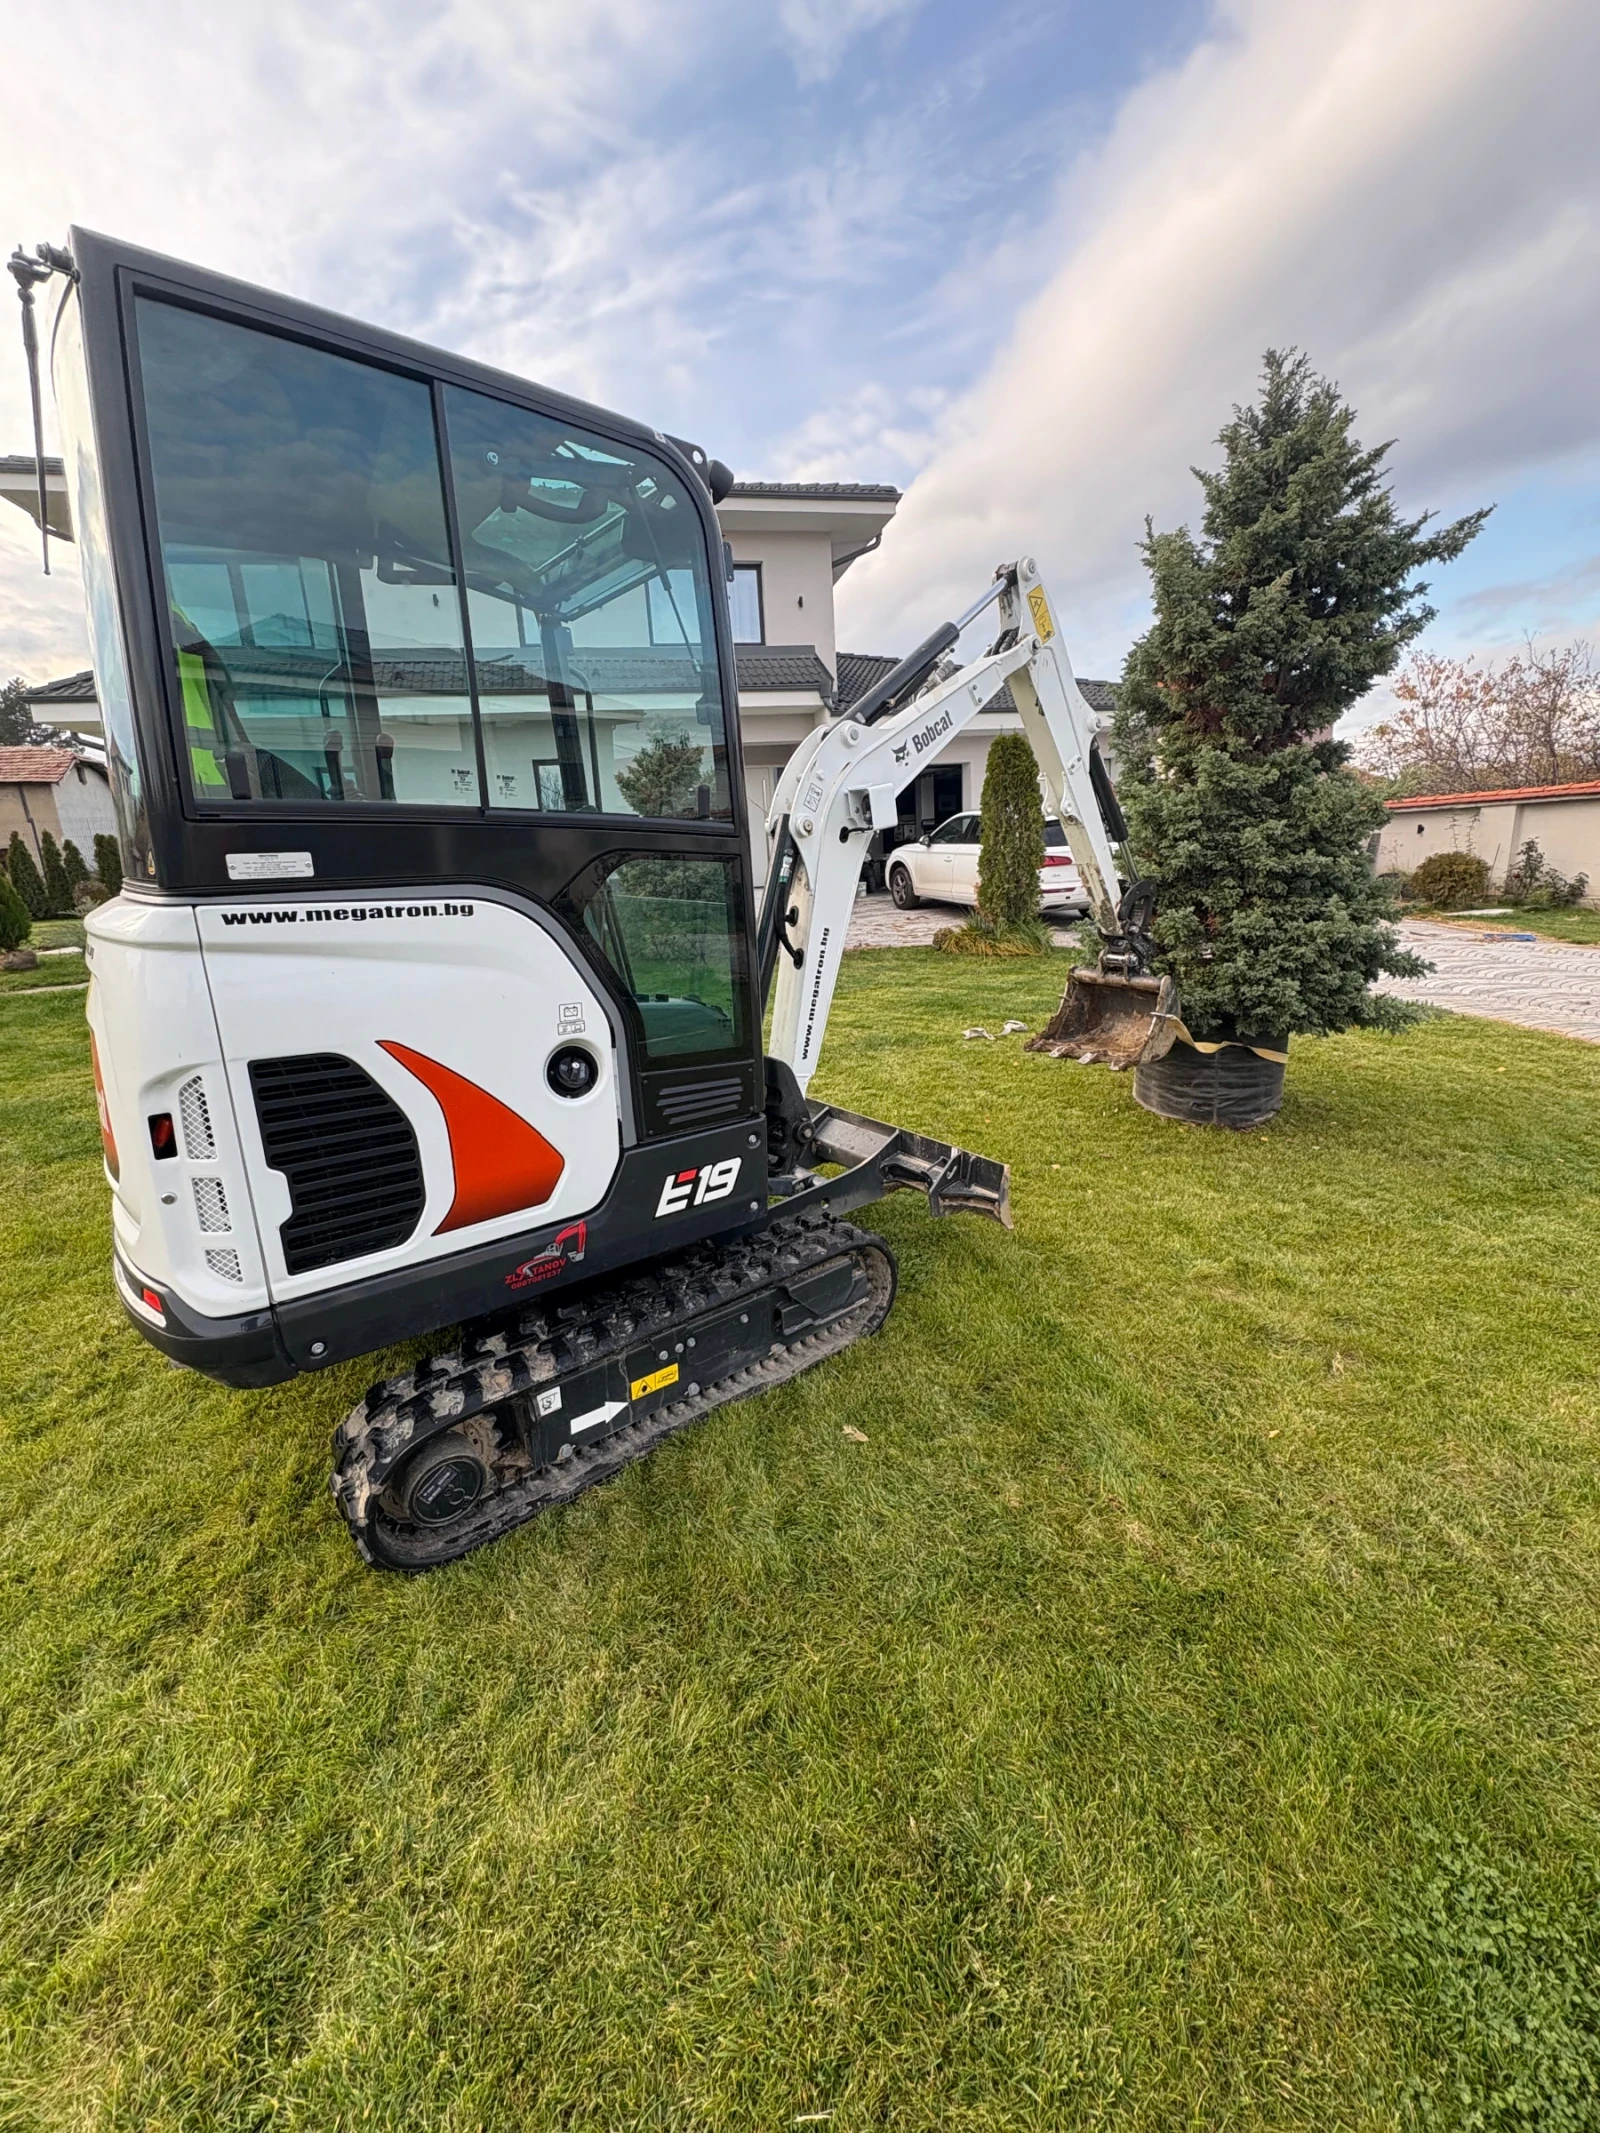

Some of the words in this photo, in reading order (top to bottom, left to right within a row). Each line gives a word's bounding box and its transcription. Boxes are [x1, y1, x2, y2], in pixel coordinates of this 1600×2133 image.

[911, 709, 954, 754] Bobcat
[221, 903, 475, 926] www.megatron.bg
[802, 927, 830, 1060] www.megatron.bg
[655, 1157, 742, 1218] E19
